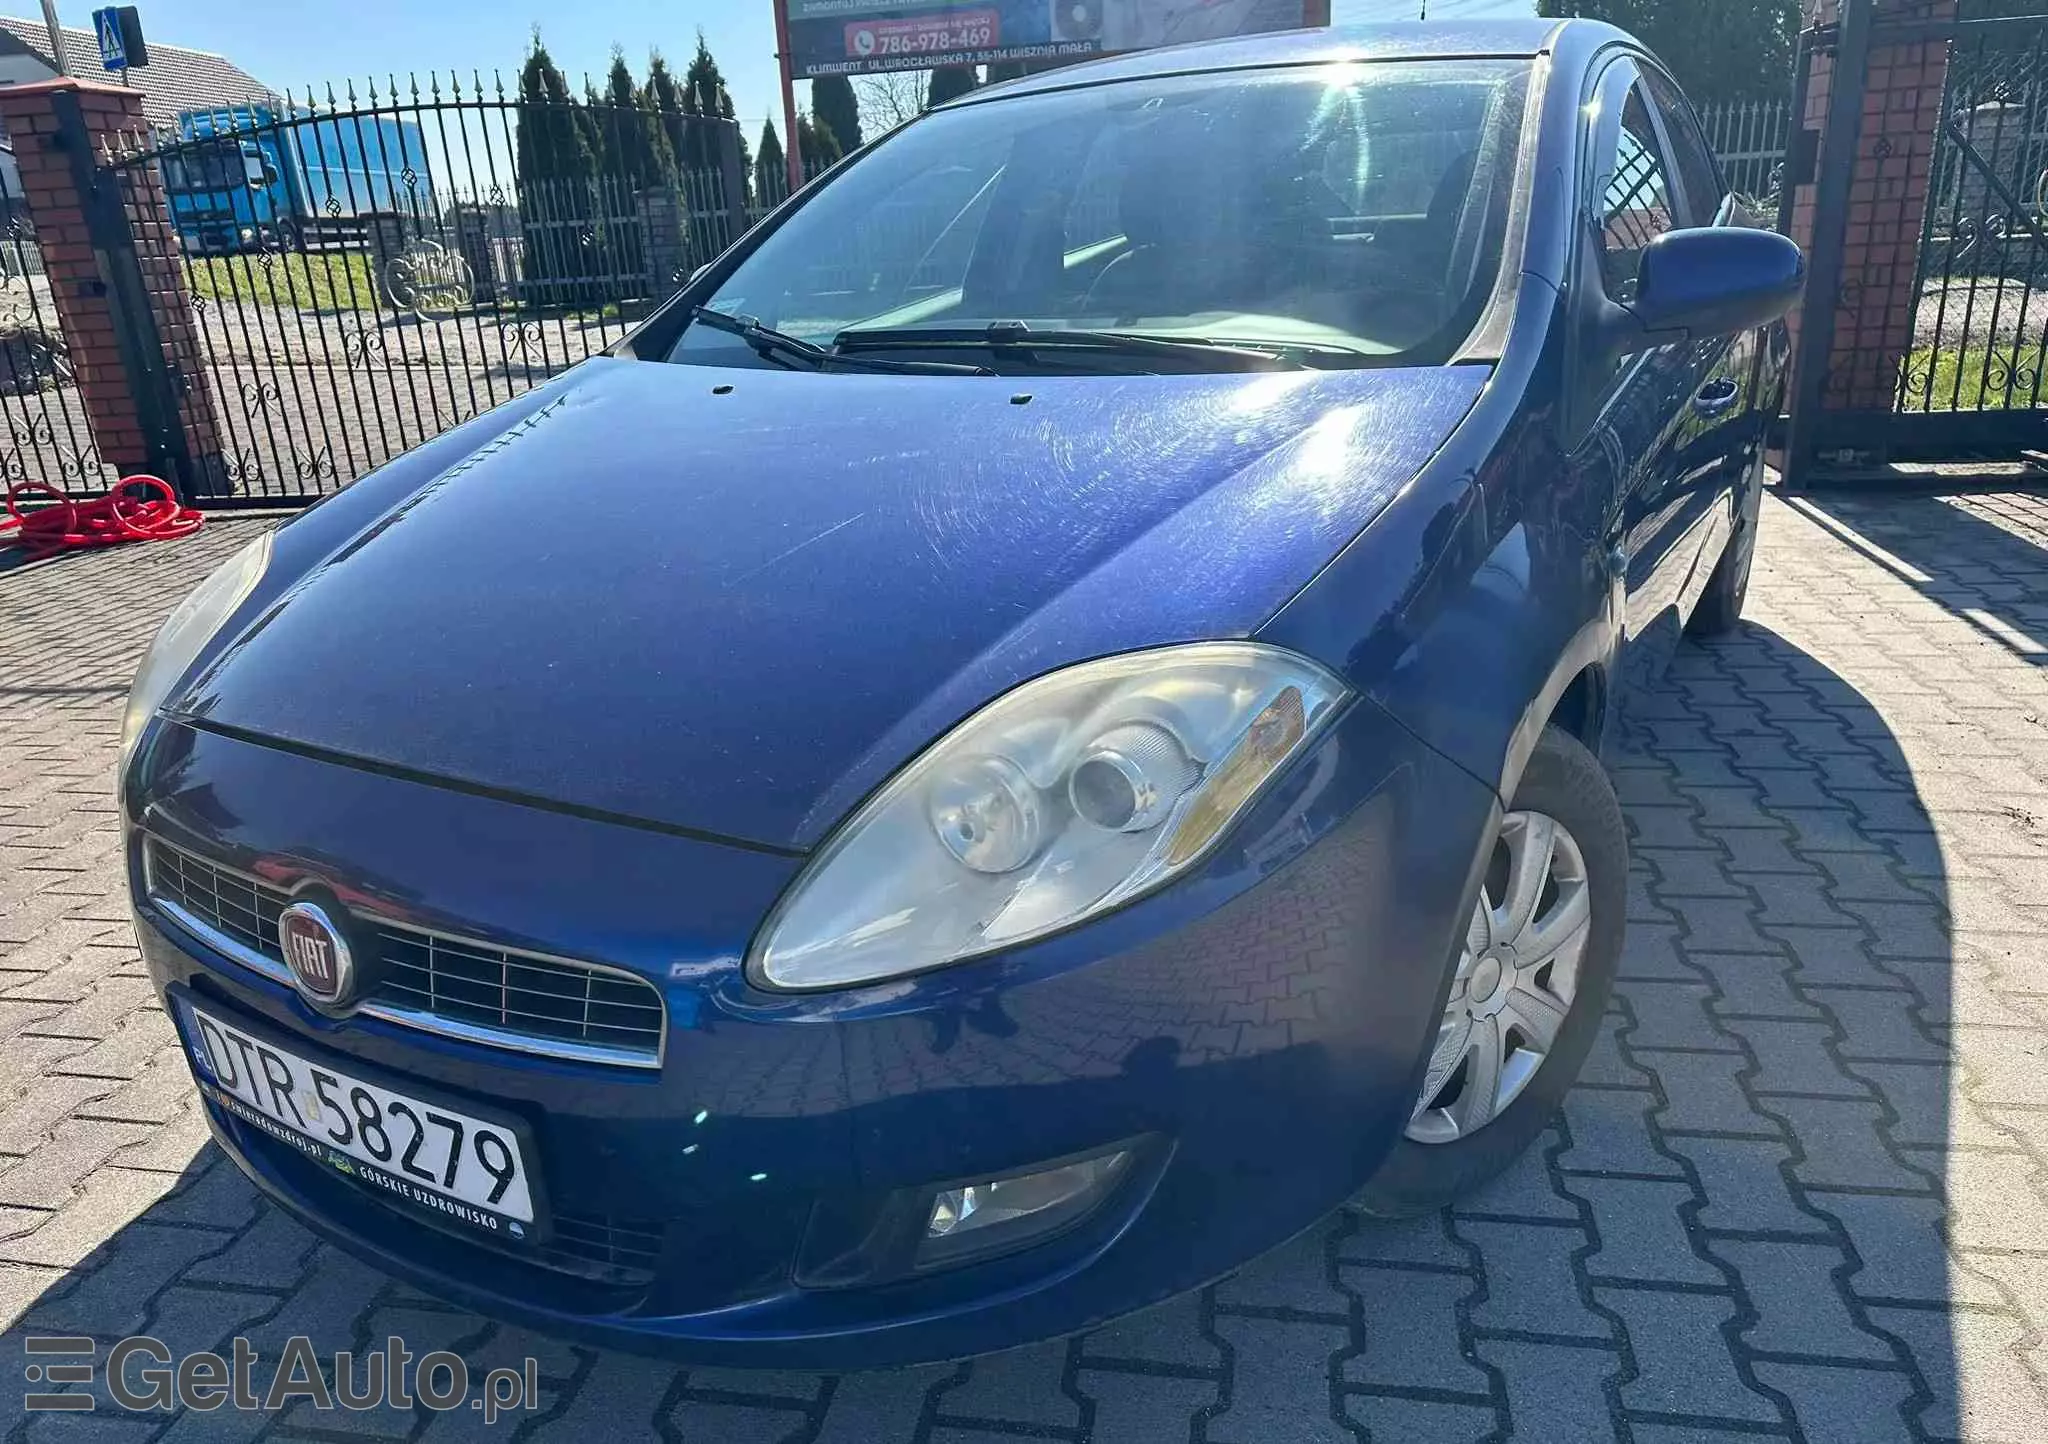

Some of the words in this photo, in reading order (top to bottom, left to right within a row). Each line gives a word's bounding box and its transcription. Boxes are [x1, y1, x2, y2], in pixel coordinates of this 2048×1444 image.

[806, 61, 862, 75] KLIMWENT
[1058, 42, 1091, 55] MAŁA
[880, 27, 990, 54] 786-978-469
[291, 931, 328, 979] FIAT
[196, 1014, 308, 1130] DTR
[311, 1069, 515, 1206] 58279
[359, 1165, 410, 1198] GÓRSKIE
[413, 1187, 498, 1231] UZDROWISKO
